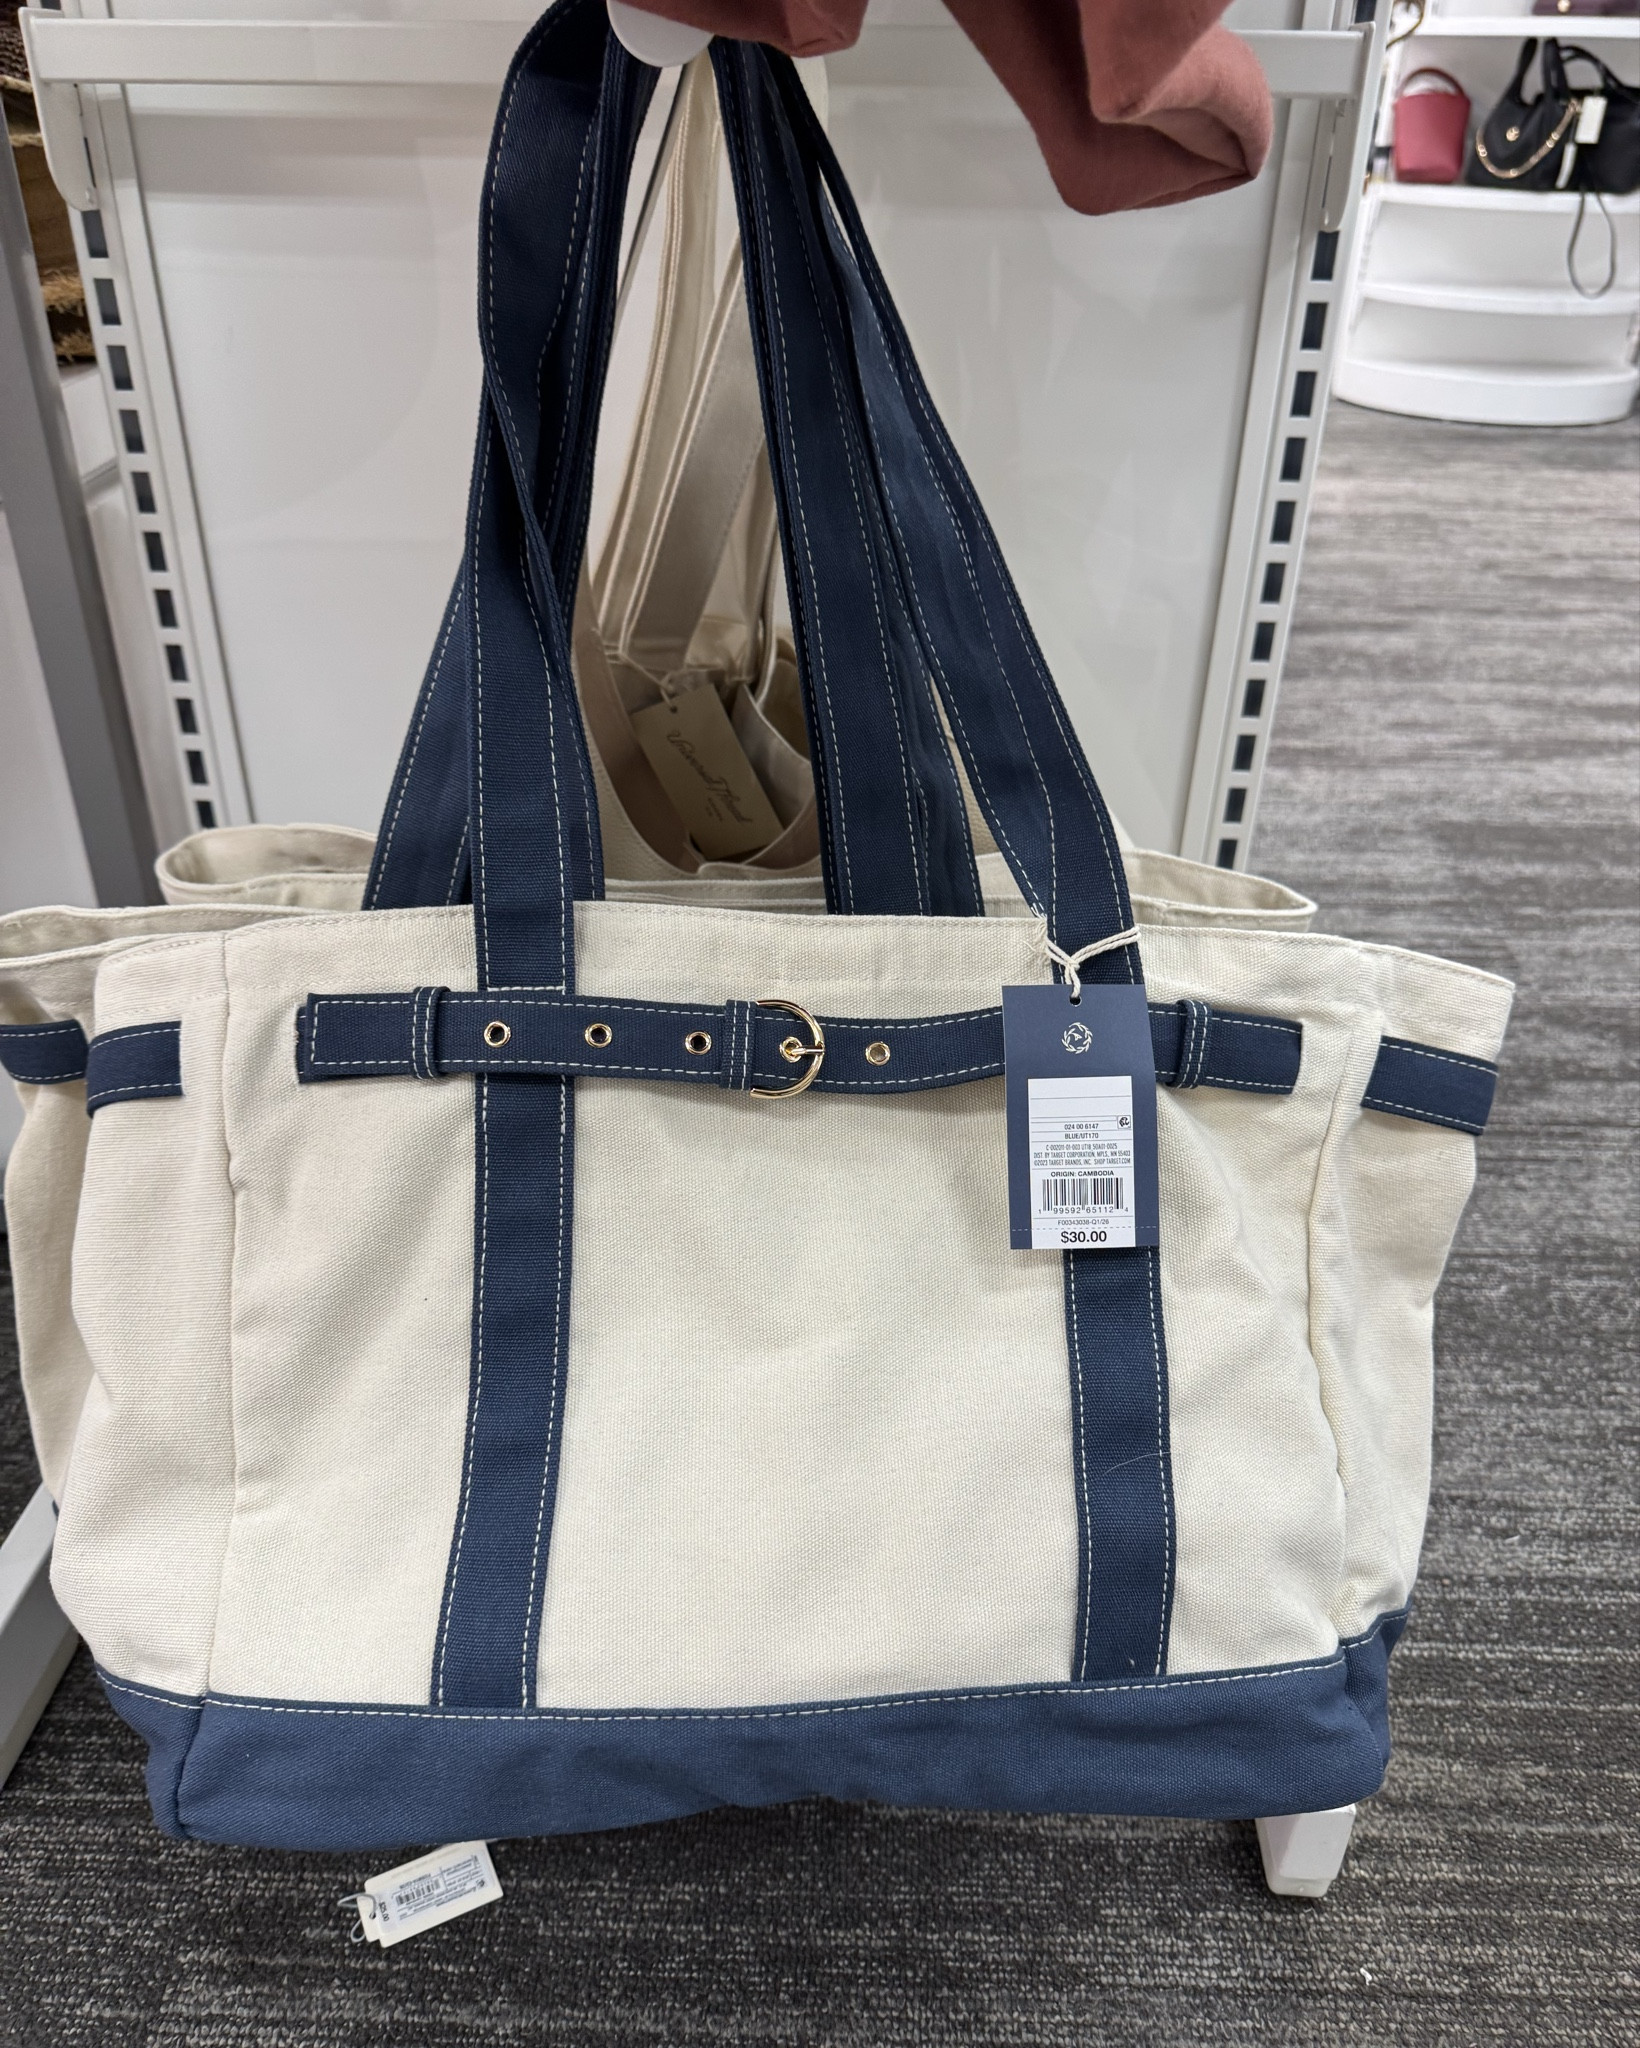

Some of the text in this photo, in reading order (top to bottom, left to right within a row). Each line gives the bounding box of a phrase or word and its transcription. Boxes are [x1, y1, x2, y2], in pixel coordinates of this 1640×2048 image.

[1064, 1132, 1099, 1140] BLUE/UT170
[1106, 1157, 1131, 1165] TARGET.COM
[1060, 1230, 1107, 1243] $30.00
